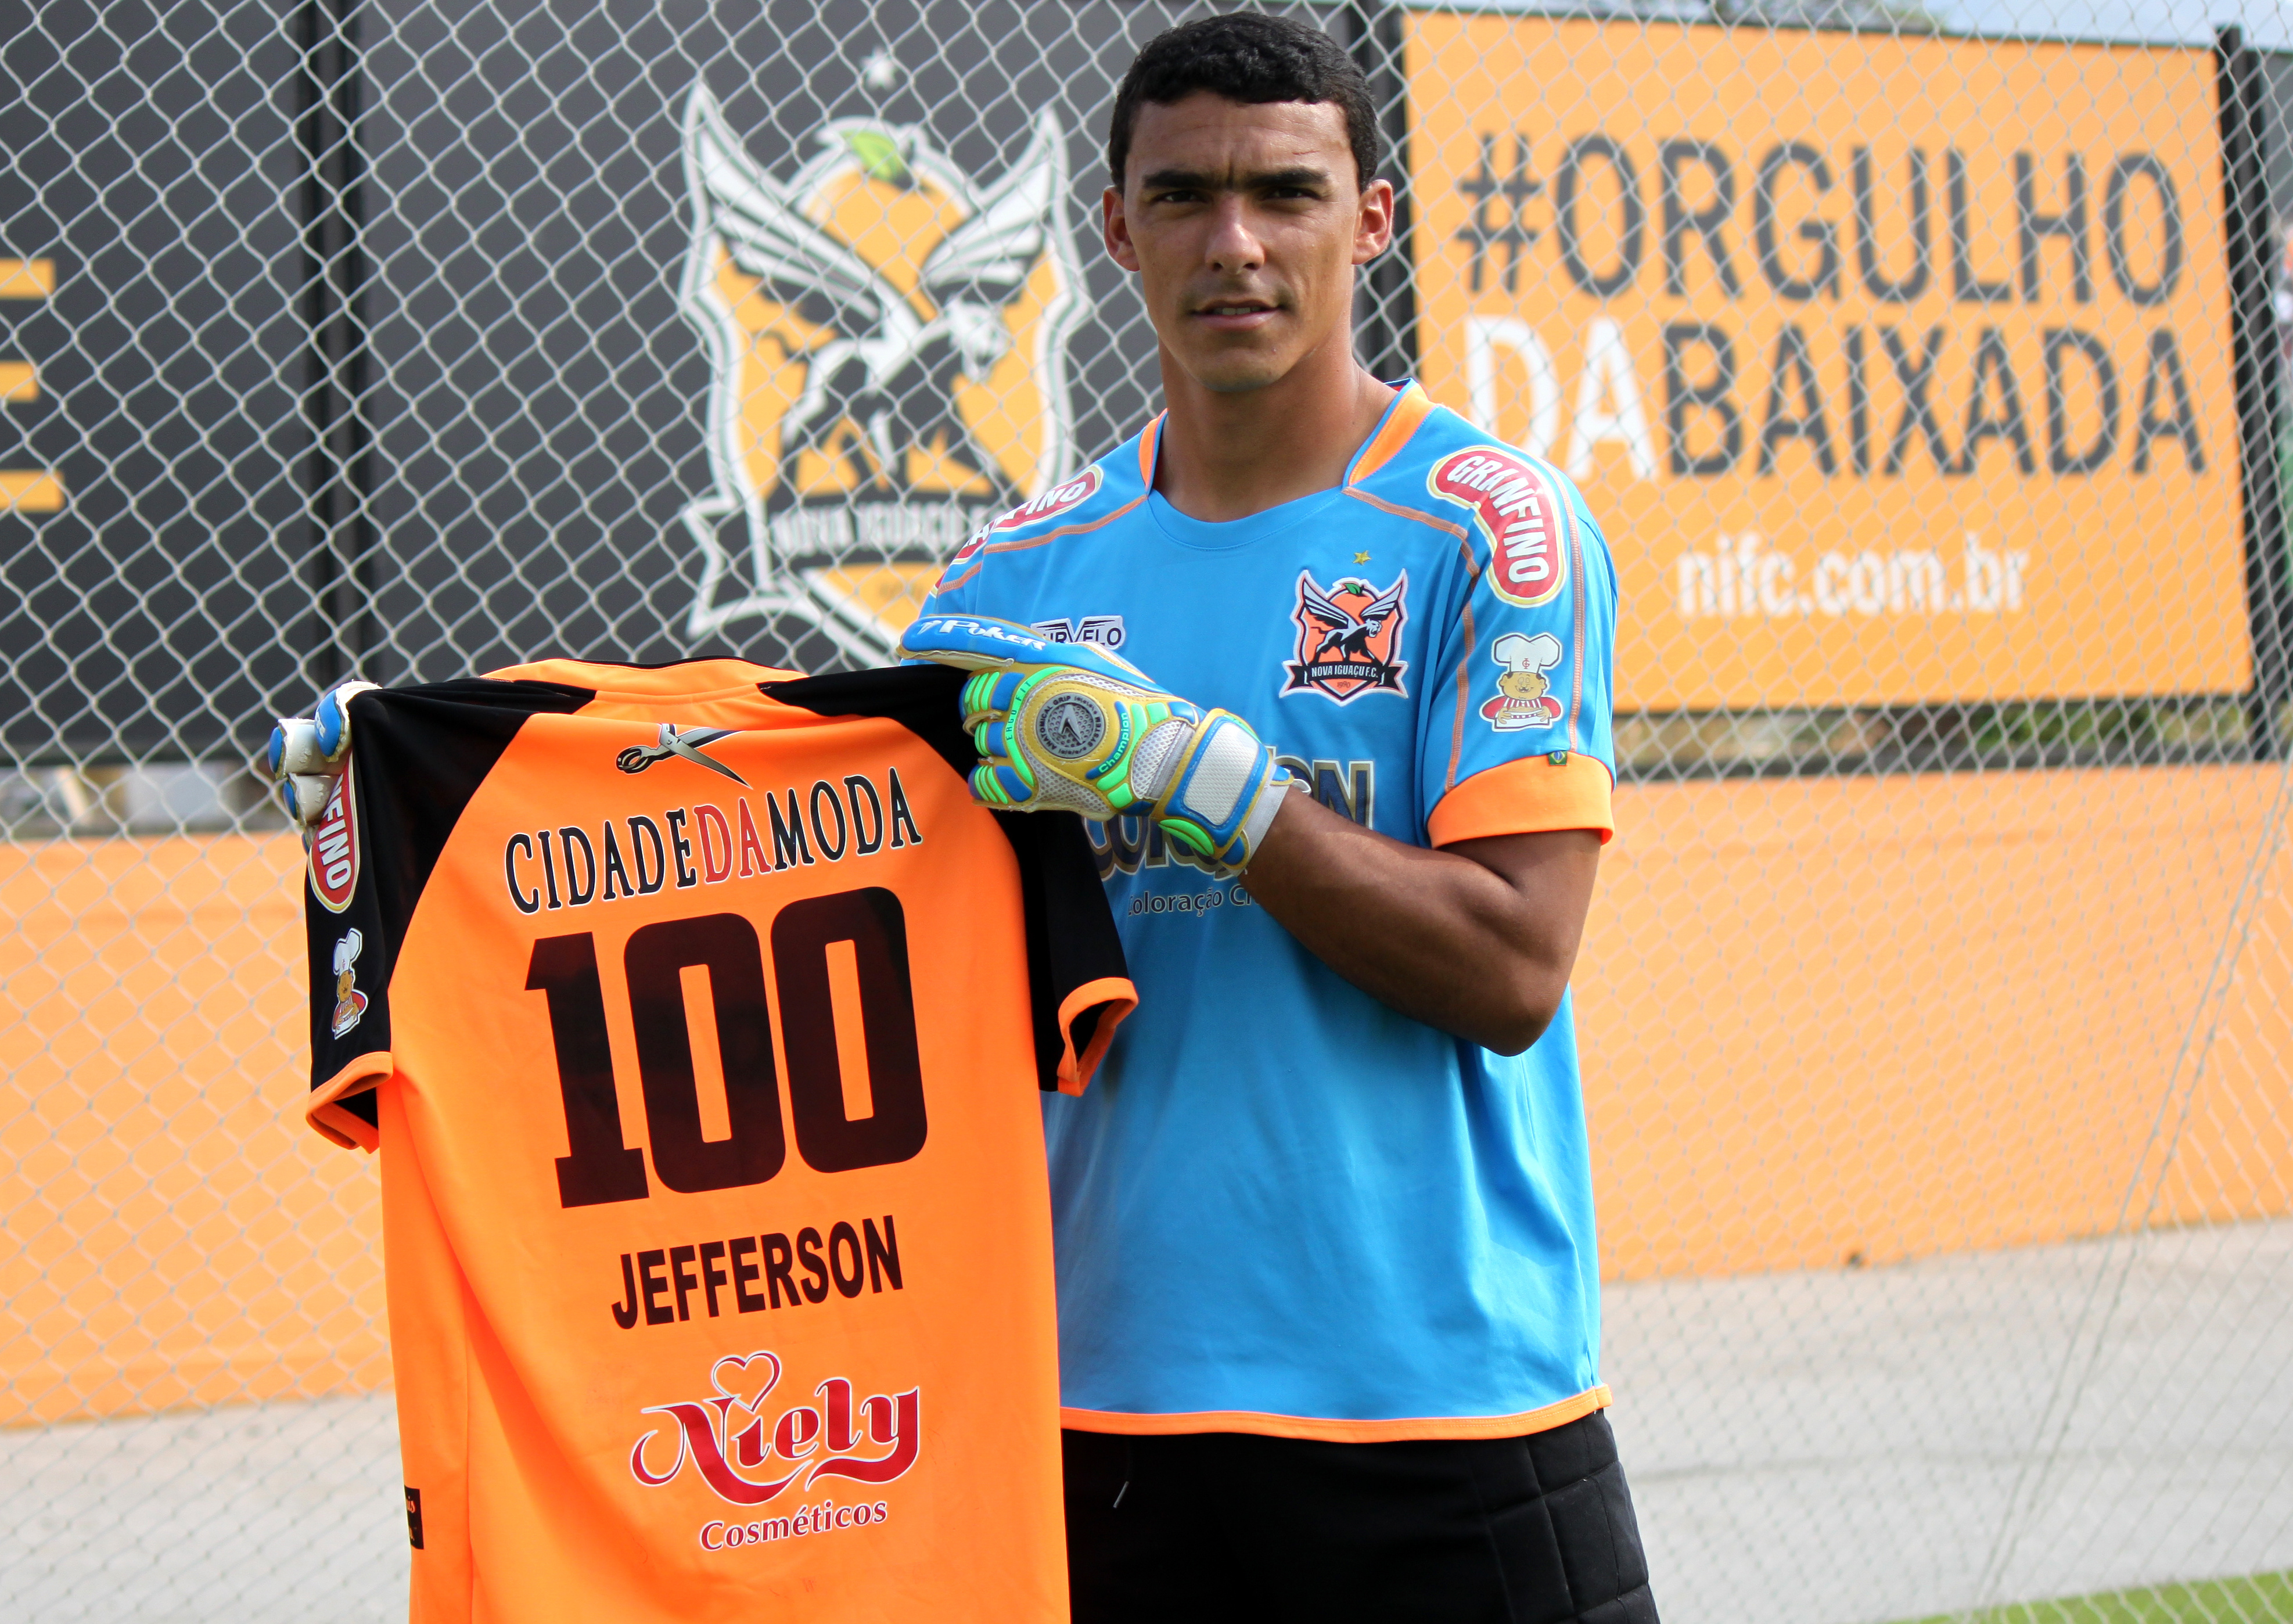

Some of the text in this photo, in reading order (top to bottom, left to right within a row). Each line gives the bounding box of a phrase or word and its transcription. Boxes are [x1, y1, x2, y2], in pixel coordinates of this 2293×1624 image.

[1454, 132, 2186, 307] #ORGULHO
[1446, 455, 1550, 583] GRANFINO
[1676, 530, 2029, 619] nifc.com.br
[1311, 665, 1379, 678] NOVA IGUAÇU F.C.
[1005, 681, 1032, 741] ERGO FIT
[1039, 695, 1071, 750] ANATOMICAL GRIP
[1087, 716, 1102, 747] SYSTEM
[1098, 712, 1130, 773] Champion
[524, 886, 928, 1209] 100
[610, 1214, 904, 1330] JEFFERSON
[630, 1350, 920, 1506] Niely
[699, 1499, 888, 1551] Cosméticos
